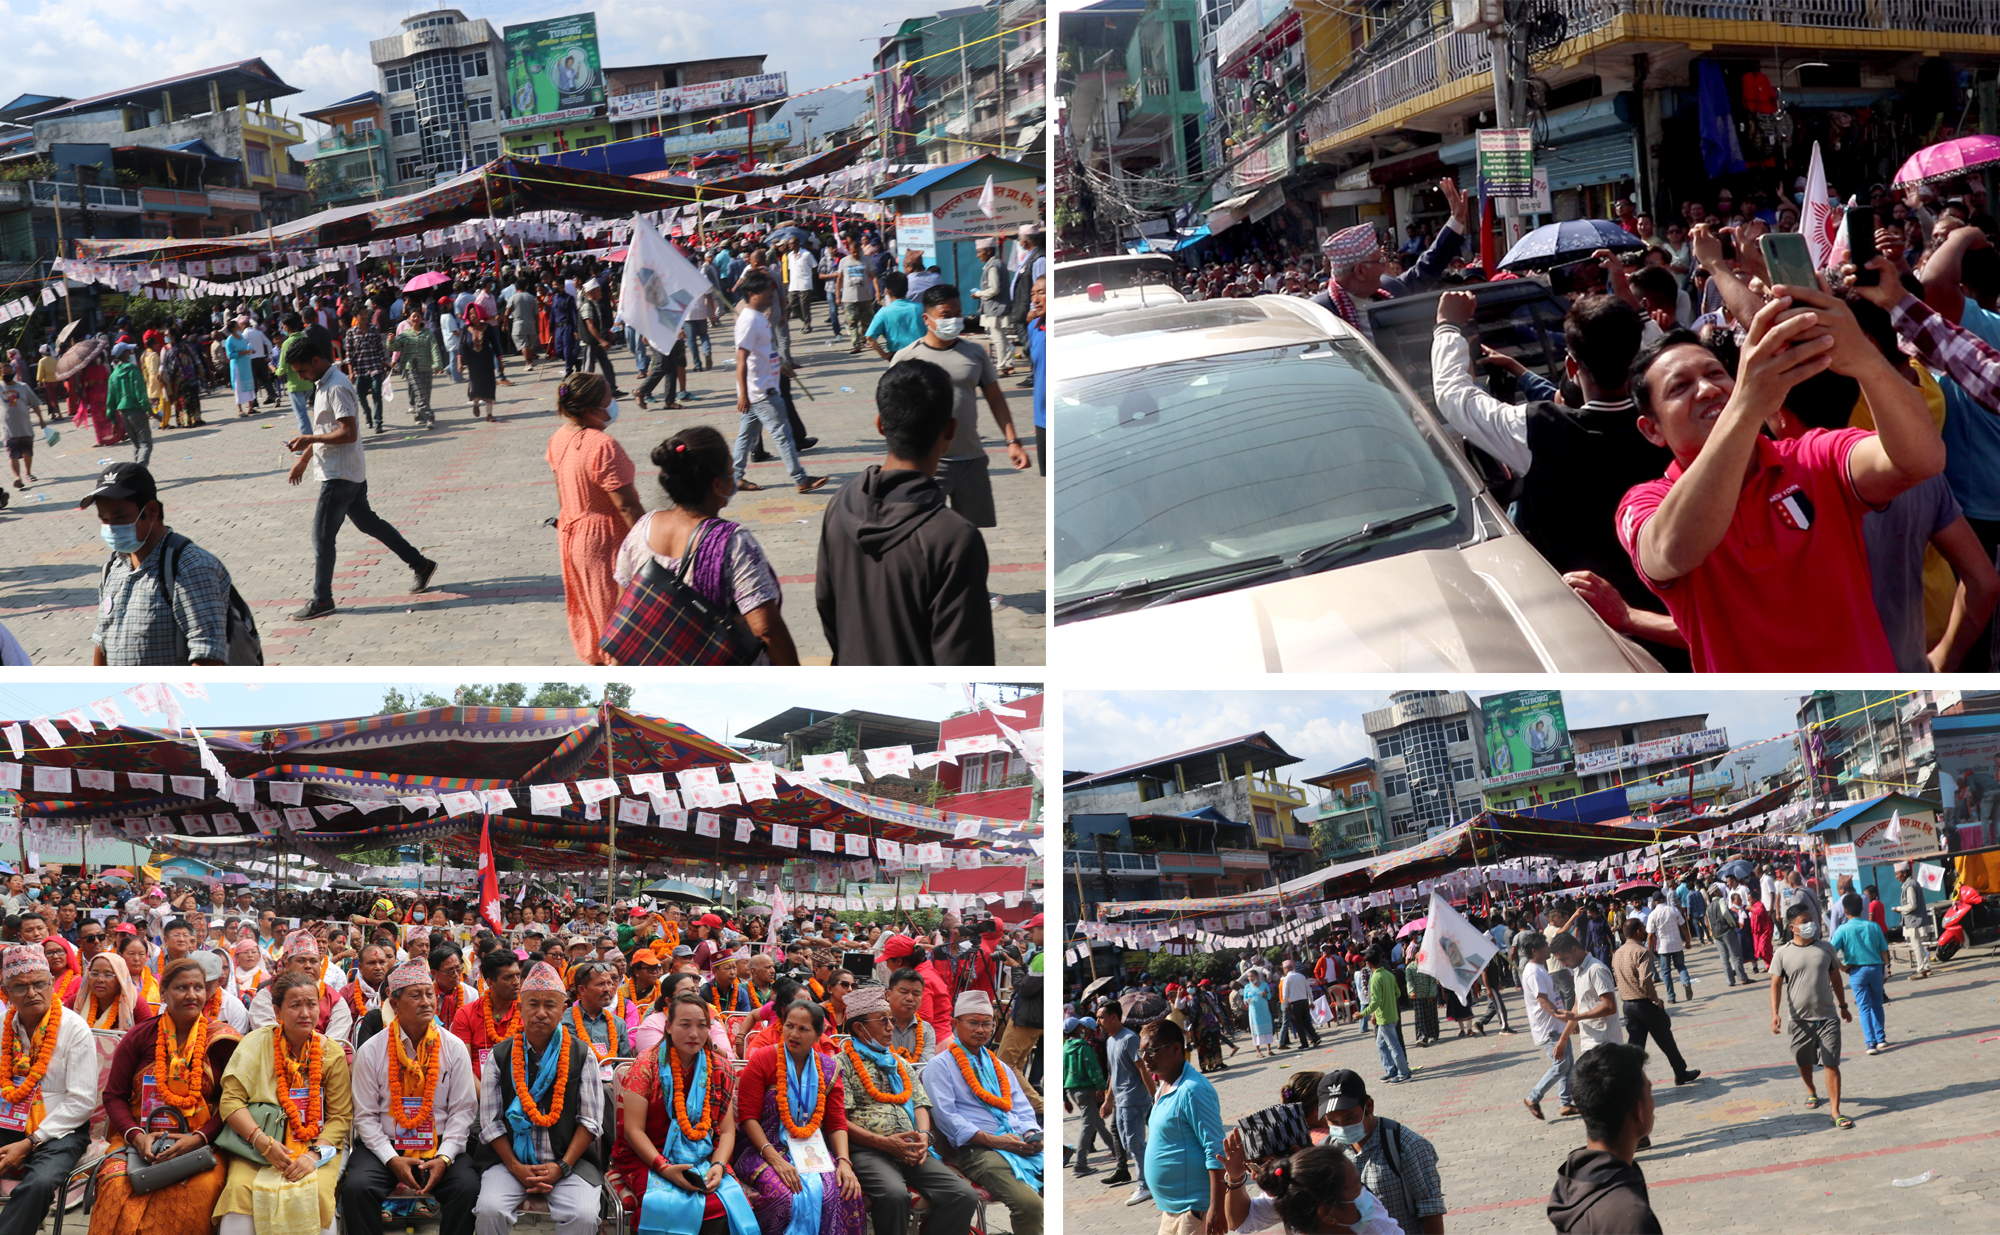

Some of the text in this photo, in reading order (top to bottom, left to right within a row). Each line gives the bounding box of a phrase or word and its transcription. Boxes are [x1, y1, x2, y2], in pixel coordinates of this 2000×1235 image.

[417, 29, 435, 39] CITY
[548, 26, 582, 39] TUBORG
[415, 36, 441, 47] PLAZA
[756, 72, 783, 82] SCHOOL
[682, 82, 721, 93] Navodaya
[631, 90, 657, 100] COLLEGE
[508, 107, 590, 126] The Best Training Centre
[1769, 484, 1800, 503] NEW YORK
[1404, 702, 1420, 710] CITY
[1520, 694, 1549, 707] TUBORG
[1402, 708, 1426, 718] PLAZA
[1700, 728, 1723, 737] SCHOOL
[1638, 738, 1671, 749] Navodaya
[1594, 748, 1616, 757] COLLEGE
[1500, 773, 1514, 781] Best
[1514, 769, 1539, 780] Training
[1540, 764, 1560, 774] Centre
[1877, 818, 1910, 830] यातात
